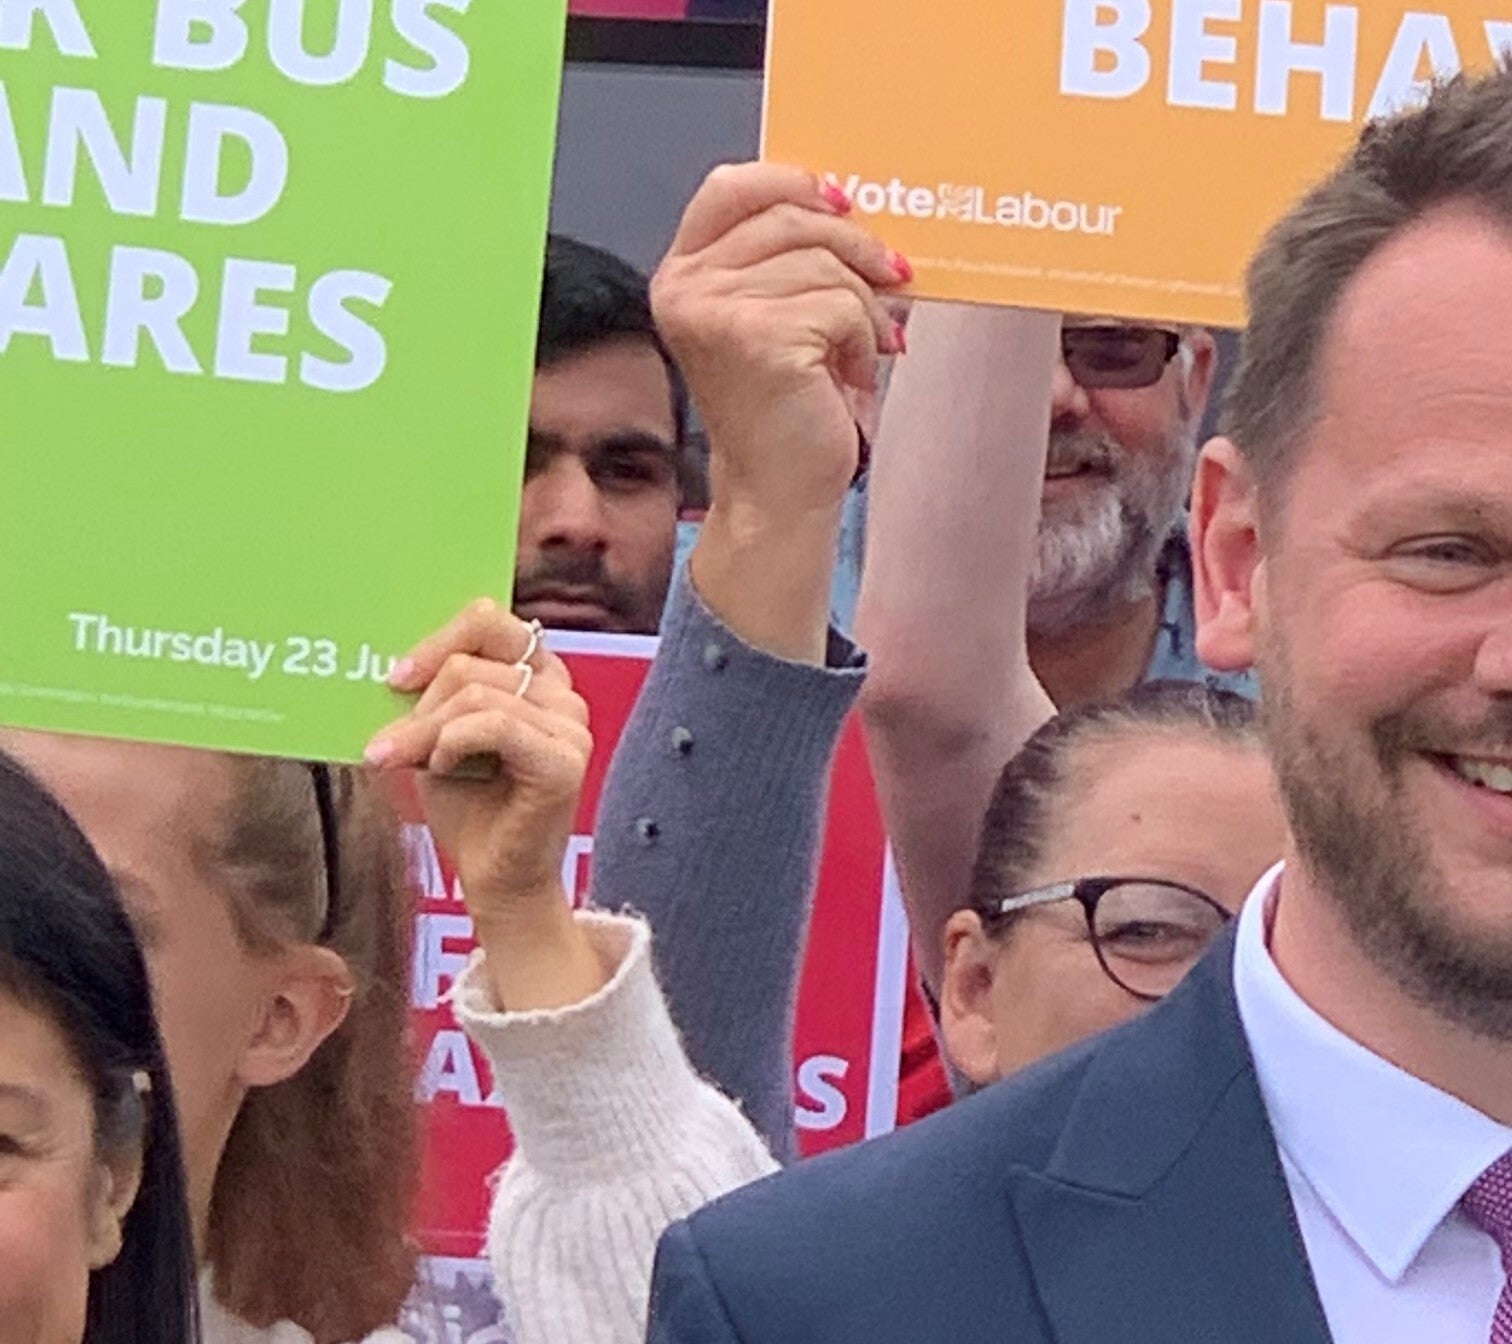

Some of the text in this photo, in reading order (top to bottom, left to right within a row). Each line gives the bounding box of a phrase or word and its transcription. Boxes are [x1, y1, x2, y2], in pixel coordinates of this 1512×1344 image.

[973, 185, 1124, 237] Labour
[67, 611, 275, 681] Thursday
[282, 636, 338, 677] 23
